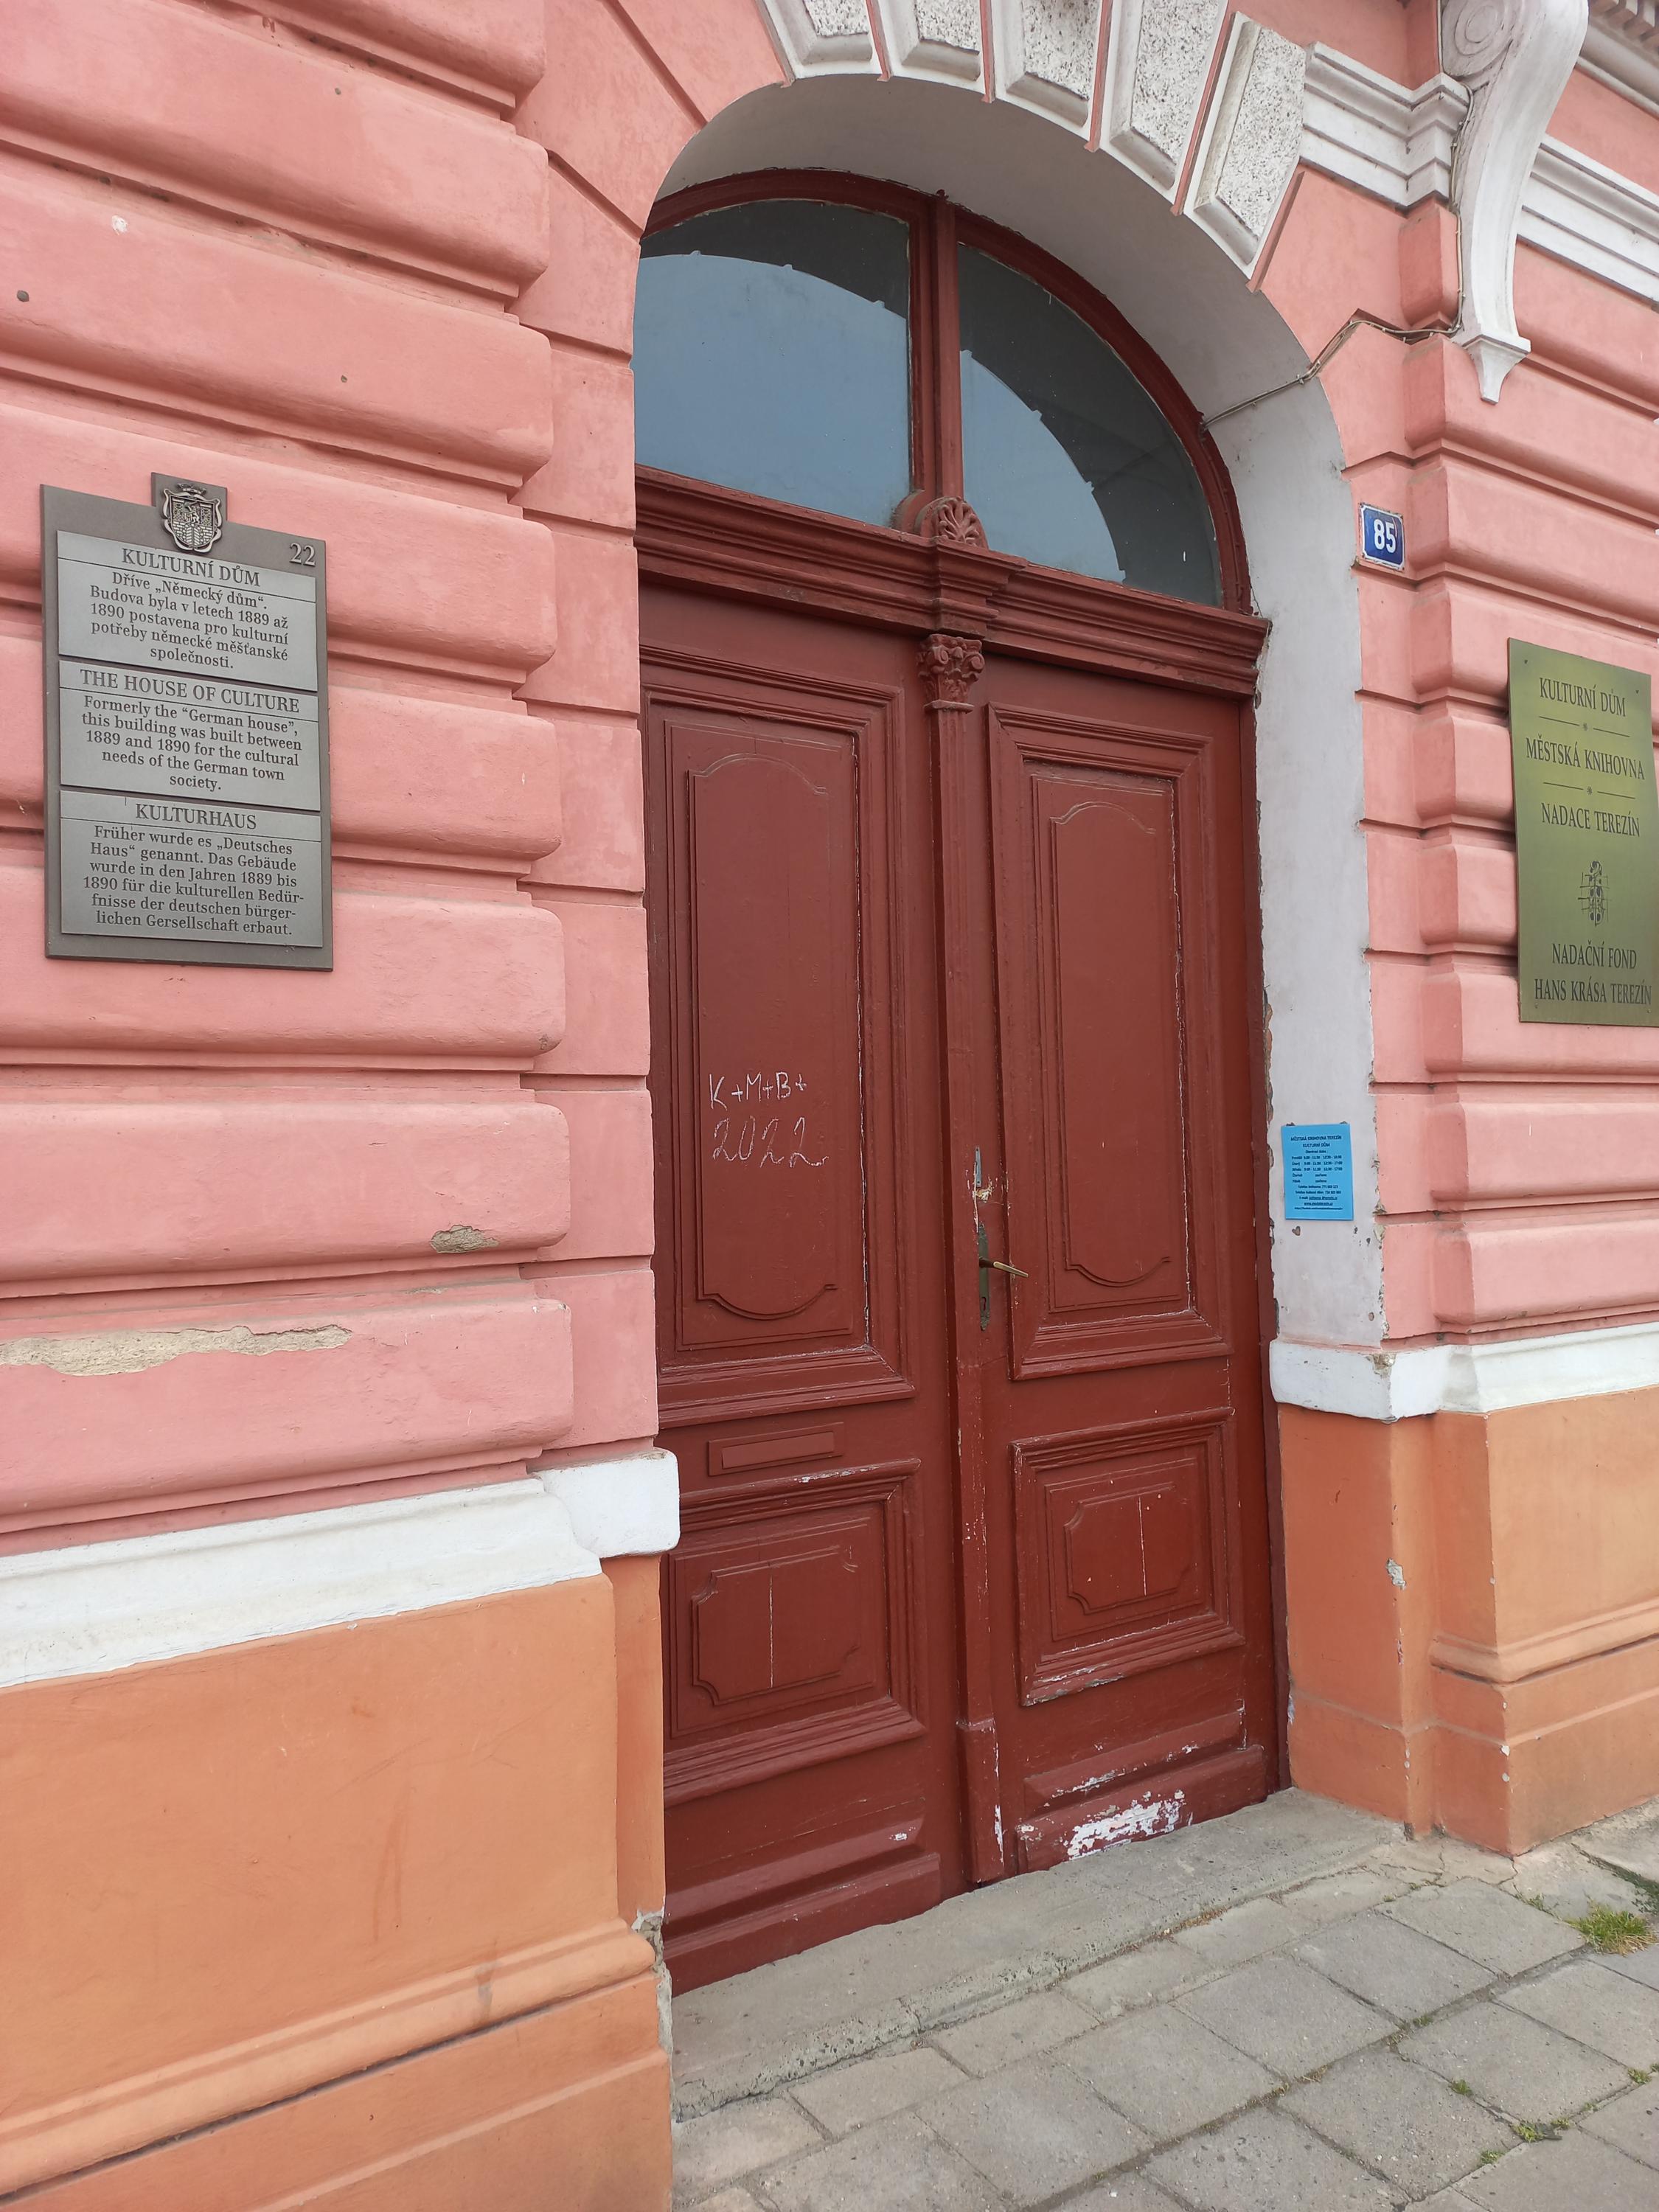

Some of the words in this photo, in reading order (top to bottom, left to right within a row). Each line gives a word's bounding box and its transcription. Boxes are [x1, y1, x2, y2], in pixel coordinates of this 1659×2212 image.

[1374, 518, 1397, 554] 85
[122, 548, 214, 579] KULTURNÍ
[219, 565, 260, 587] DŮM
[289, 542, 316, 568] 22
[90, 585, 144, 605] Budova
[148, 594, 177, 611] byla
[181, 603, 189, 612] v
[192, 601, 234, 620] letech
[238, 610, 269, 625] 1889
[274, 616, 288, 629] až
[112, 571, 150, 590] Dříve
[155, 580, 223, 605] „Německý
[227, 591, 267, 610] dům“.
[91, 602, 124, 619] 1890
[129, 611, 201, 631] postavena
[204, 623, 228, 636] pro
[231, 624, 288, 645] kulturní
[91, 622, 147, 641] potřeby
[151, 629, 212, 649] německé
[216, 640, 288, 661] měšťanské
[150, 644, 236, 669] společnosti.
[80, 669, 118, 689] THE
[124, 675, 187, 698] HOUSE
[193, 685, 216, 701] OF
[221, 689, 299, 713] CULTURE
[1539, 677, 1596, 710] KULTURNÍ
[1600, 689, 1626, 717] DŮM
[81, 712, 110, 727] this
[114, 714, 176, 738] building
[180, 727, 206, 739] was
[209, 727, 243, 743] built
[247, 731, 302, 751] between
[84, 695, 151, 718] Formerly
[154, 704, 177, 719] the
[182, 707, 243, 727] “German
[248, 715, 298, 737] house”,
[86, 730, 120, 745] 1889
[125, 736, 153, 749] and
[157, 738, 190, 754] 1890
[195, 742, 215, 757] for
[219, 745, 241, 759] the
[245, 749, 299, 766] cultural
[102, 751, 145, 765] needs
[149, 754, 164, 767] of
[167, 755, 189, 770] the
[193, 759, 248, 778] German
[252, 767, 285, 781] town
[1526, 733, 1581, 768] MĚSTSKÁ
[1584, 749, 1645, 780] KNIHOVNA
[170, 776, 221, 793] society.
[136, 804, 257, 830] KULTURHAUS
[1541, 802, 1590, 830] NADACE
[1593, 810, 1640, 838] TEREZÍN
[91, 842, 135, 857] Haus“
[140, 849, 204, 863] genannt.
[208, 852, 233, 866] Das
[237, 855, 296, 871] Gebäude
[94, 825, 145, 841] Früher
[148, 832, 193, 846] wurde
[198, 838, 212, 847] es
[217, 837, 292, 855] „Deutsches
[83, 876, 117, 890] 1890
[122, 878, 145, 892] für
[150, 880, 171, 894] die
[175, 881, 254, 900] kulturellen
[258, 889, 304, 903] Bedür-
[89, 860, 135, 874] wurde
[139, 863, 155, 876] in
[159, 864, 185, 878] den
[188, 867, 236, 883] Jahren
[240, 872, 272, 885] 1889
[276, 873, 297, 887] bis
[91, 893, 136, 908] fnisse
[141, 896, 164, 911] der
[169, 898, 241, 915] deutschen
[245, 903, 296, 921] bürger-
[96, 910, 142, 926] lichen
[146, 914, 239, 932] Gersellschaft
[243, 921, 292, 935] erbaut.
[1552, 939, 1604, 967] NADAČNÍ
[1608, 947, 1637, 970] FOND
[1534, 978, 1566, 1001] HANS
[1571, 975, 1607, 1003] KRÁSA
[1610, 979, 1652, 1005] TEREZÍN
[712, 1115, 830, 1168] 2022
